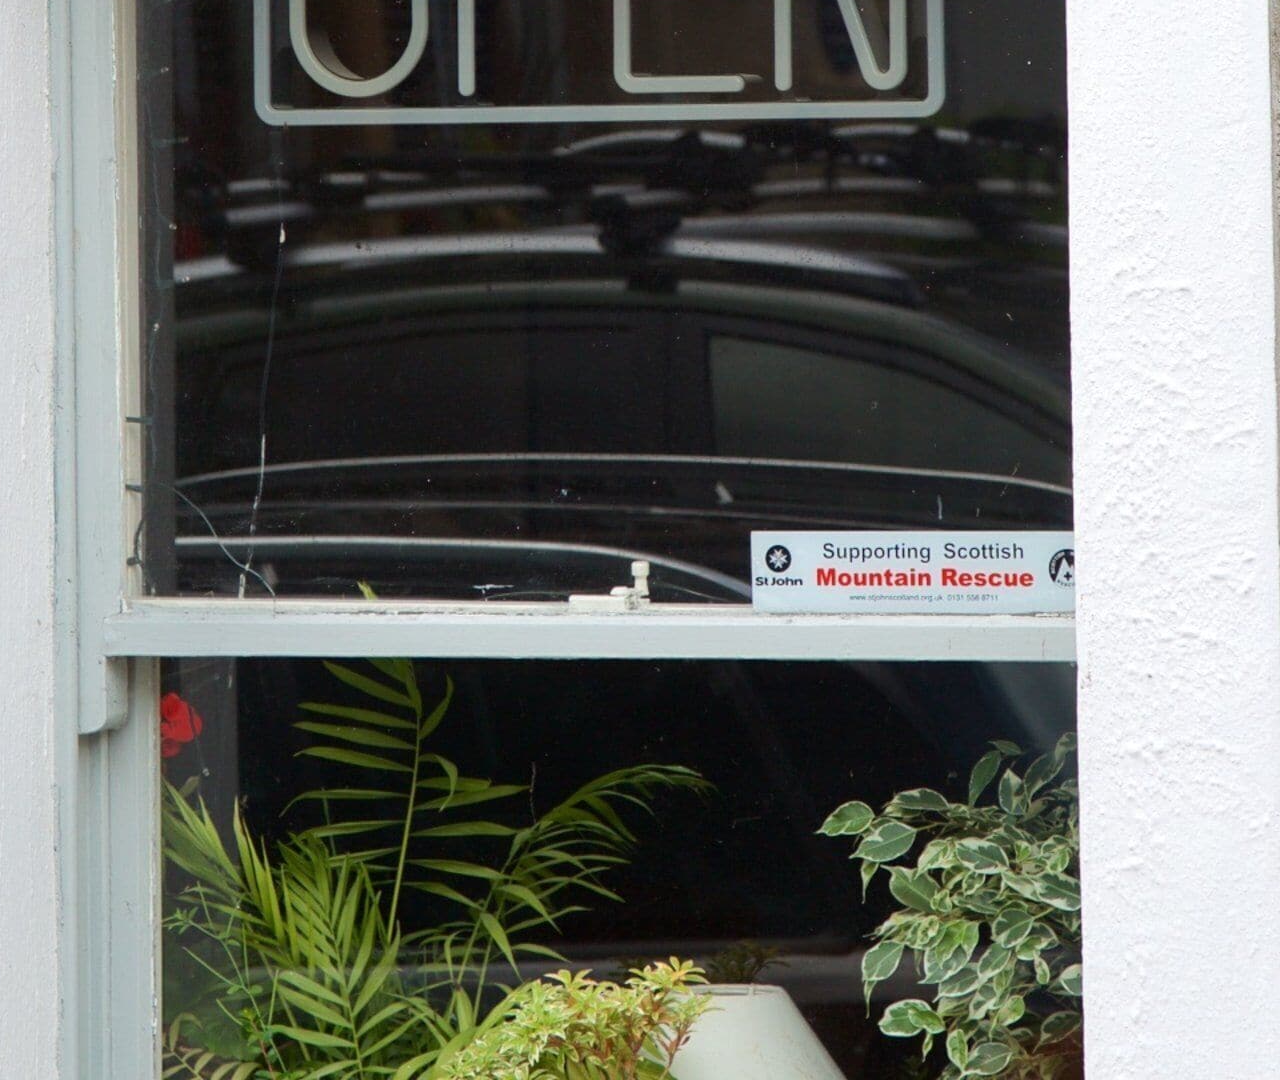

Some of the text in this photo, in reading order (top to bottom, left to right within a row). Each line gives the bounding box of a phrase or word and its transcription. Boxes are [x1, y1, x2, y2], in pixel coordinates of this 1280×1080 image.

[822, 542, 1024, 563] Supporting Scottish
[770, 576, 804, 587] John
[816, 567, 1035, 587] Mountain Rescue
